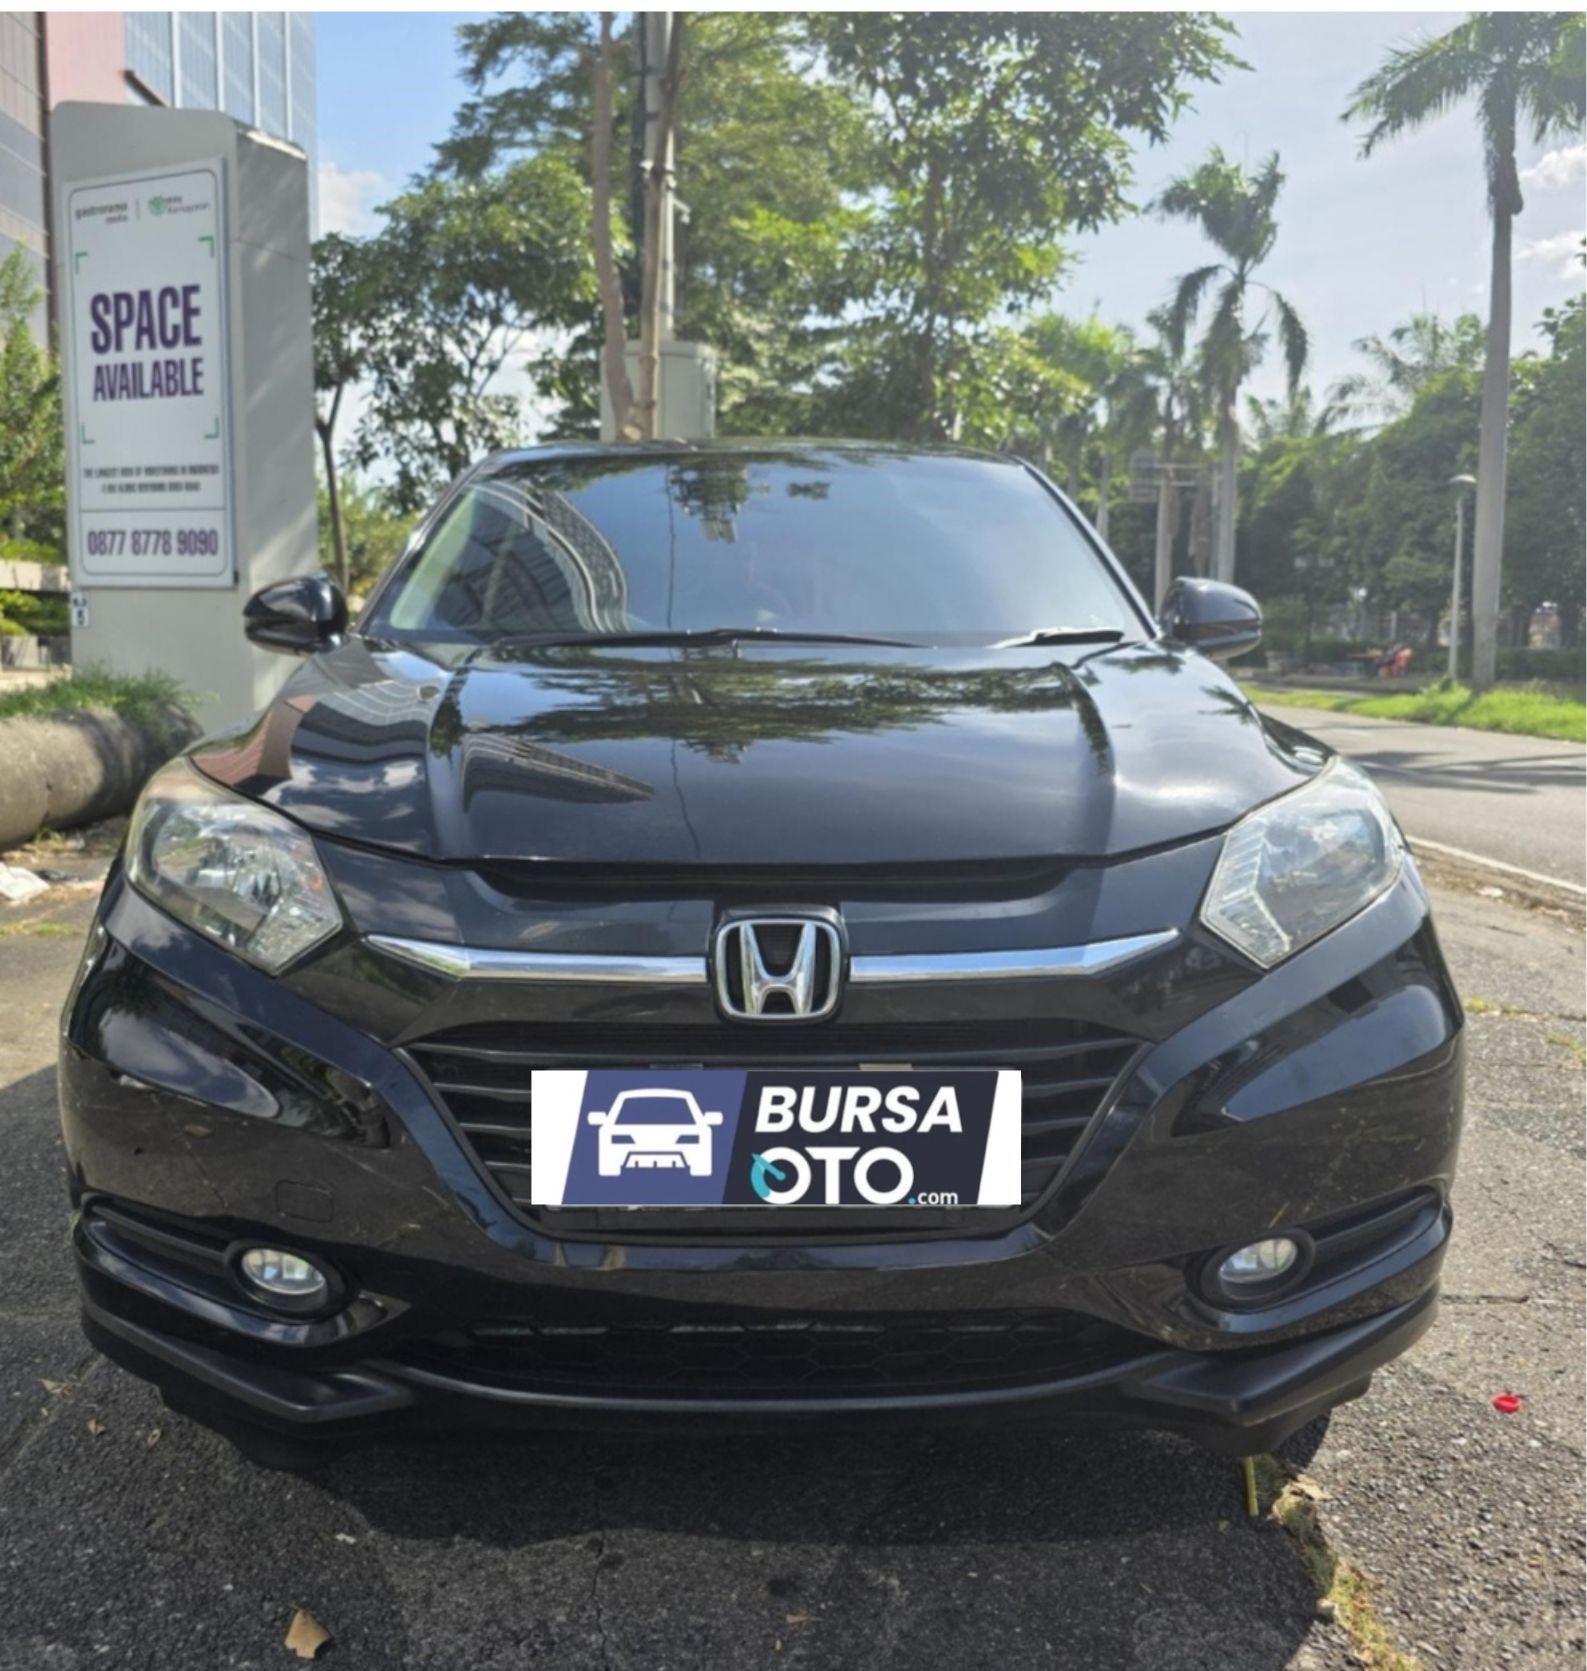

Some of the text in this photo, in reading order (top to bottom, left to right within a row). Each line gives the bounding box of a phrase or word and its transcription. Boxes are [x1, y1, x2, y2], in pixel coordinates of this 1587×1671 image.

[90, 284, 203, 355] SPACE
[93, 357, 204, 402] AVAILABLE
[87, 528, 219, 556] 0877 8778 9090
